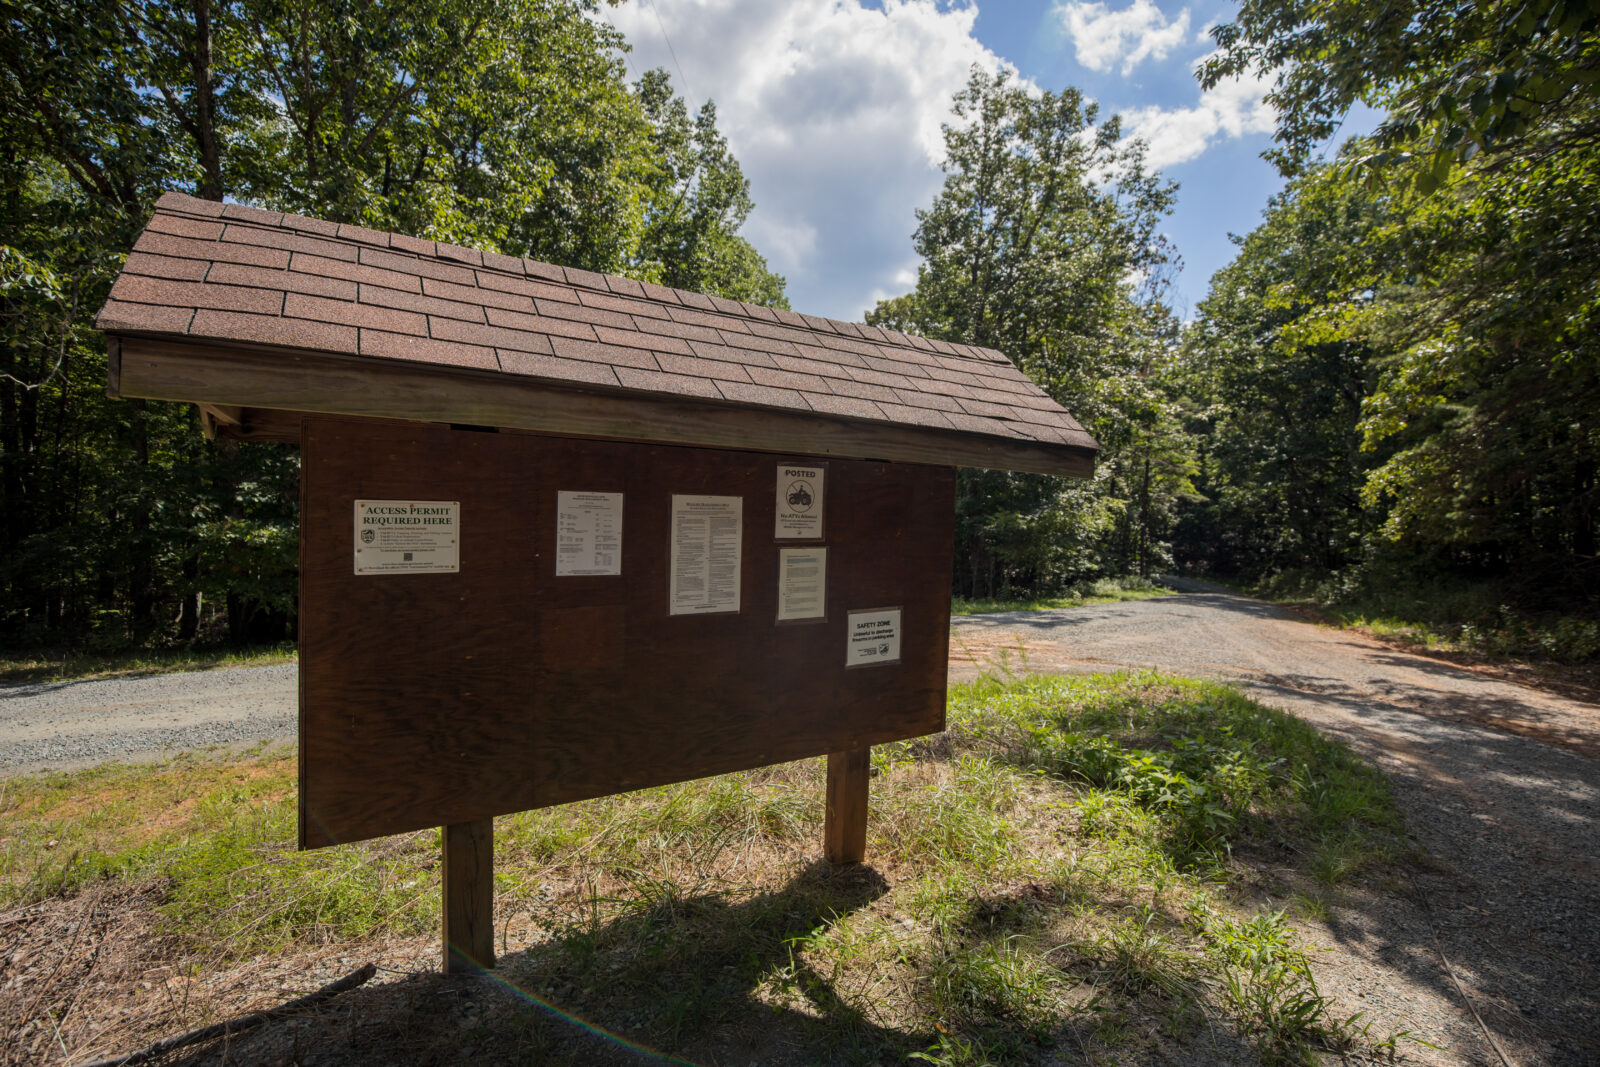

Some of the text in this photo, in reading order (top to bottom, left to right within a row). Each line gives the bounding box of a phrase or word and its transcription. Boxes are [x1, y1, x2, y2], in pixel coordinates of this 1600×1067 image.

[785, 470, 816, 478] POSTED
[366, 507, 451, 515] ACCESS PERMIT
[363, 516, 453, 526] REQUIRED HERE
